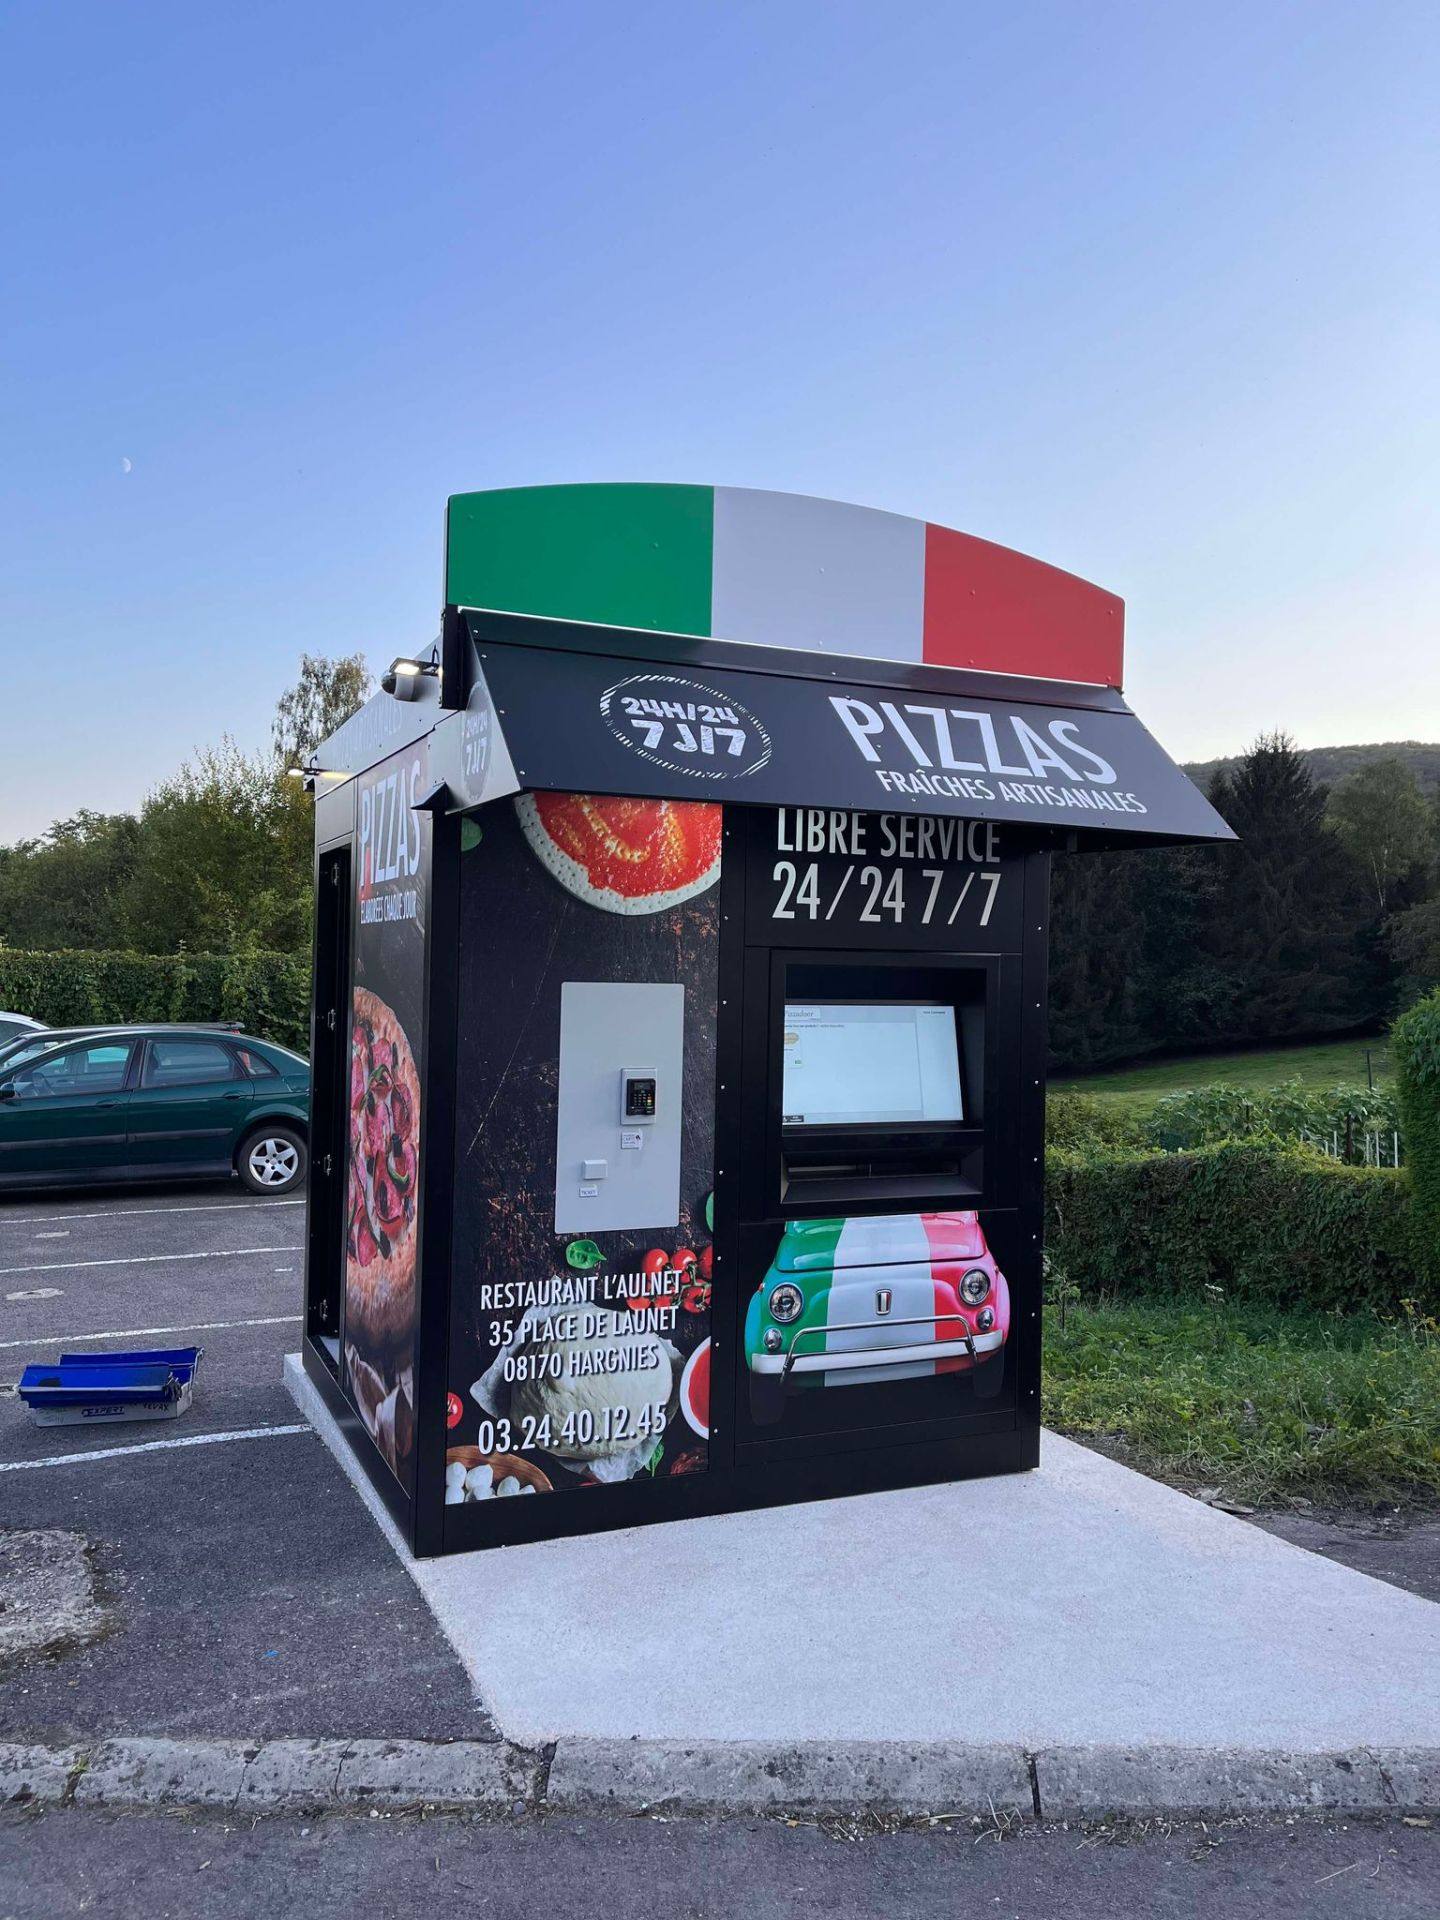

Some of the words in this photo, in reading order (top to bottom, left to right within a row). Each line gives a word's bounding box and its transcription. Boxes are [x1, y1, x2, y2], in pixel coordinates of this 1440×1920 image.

[621, 697, 739, 724] 24H/24
[829, 696, 1117, 785] PIZZAS
[875, 769, 996, 801] FRAÎCHES
[998, 781, 1148, 814] ARTISANALES
[360, 760, 421, 887] PIZZAS
[778, 807, 868, 855] LIBRE
[880, 814, 1000, 863] SERVICE
[480, 1275, 599, 1310] RESTAURANT
[604, 1270, 682, 1300] L'AULNET
[489, 1320, 513, 1347] 35
[521, 1313, 577, 1343] PLACE
[583, 1311, 606, 1337] DE
[612, 1305, 679, 1336] LAUNET
[503, 1352, 562, 1382] 08170
[569, 1344, 659, 1376] HARGNIES
[478, 1402, 667, 1455] 03.24.40.12.45
